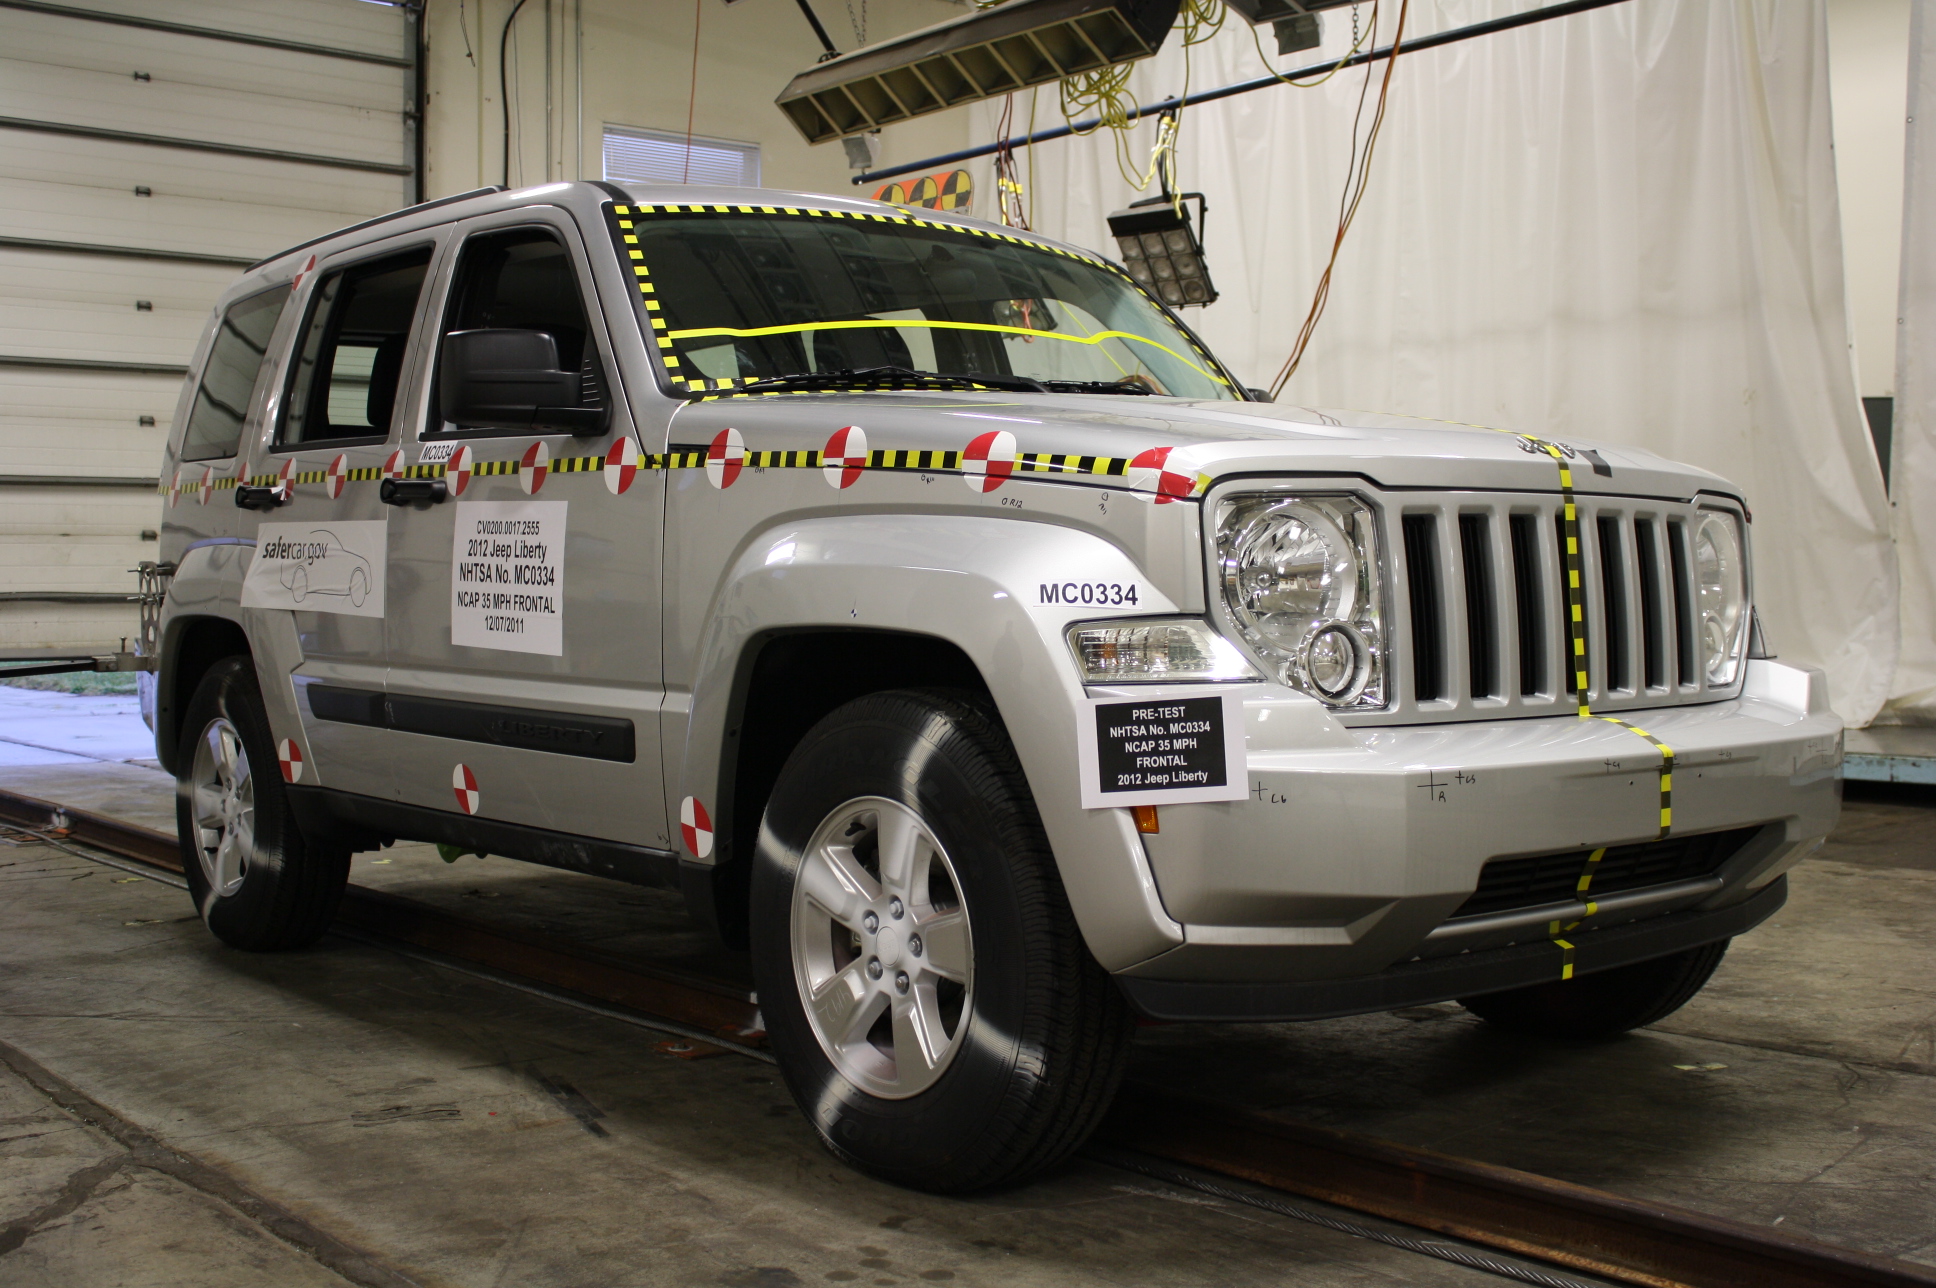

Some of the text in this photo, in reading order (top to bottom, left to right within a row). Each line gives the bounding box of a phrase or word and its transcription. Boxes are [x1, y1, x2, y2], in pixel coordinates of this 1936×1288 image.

[421, 444, 455, 461] MC0334
[476, 520, 540, 535] CV0200.0017.2555
[262, 535, 329, 566] safercar.gov
[468, 539, 547, 564] 2012 Jeep Liberty
[459, 562, 555, 586] NHTSA No. MC0334
[457, 591, 555, 614] NCAP 35 MPH FRONTAL
[1039, 582, 1139, 606] MC0334
[485, 615, 524, 634] 12/07/2011
[1132, 706, 1186, 721] PRE-TEST
[500, 719, 604, 745] LIBERTY
[1109, 720, 1211, 738] NHTSA No. MC0334
[1125, 738, 1197, 753] NCAP 35 MPH
[1136, 754, 1188, 768] FRONTAL
[1117, 770, 1209, 786] 2012 Jeep Liberty
